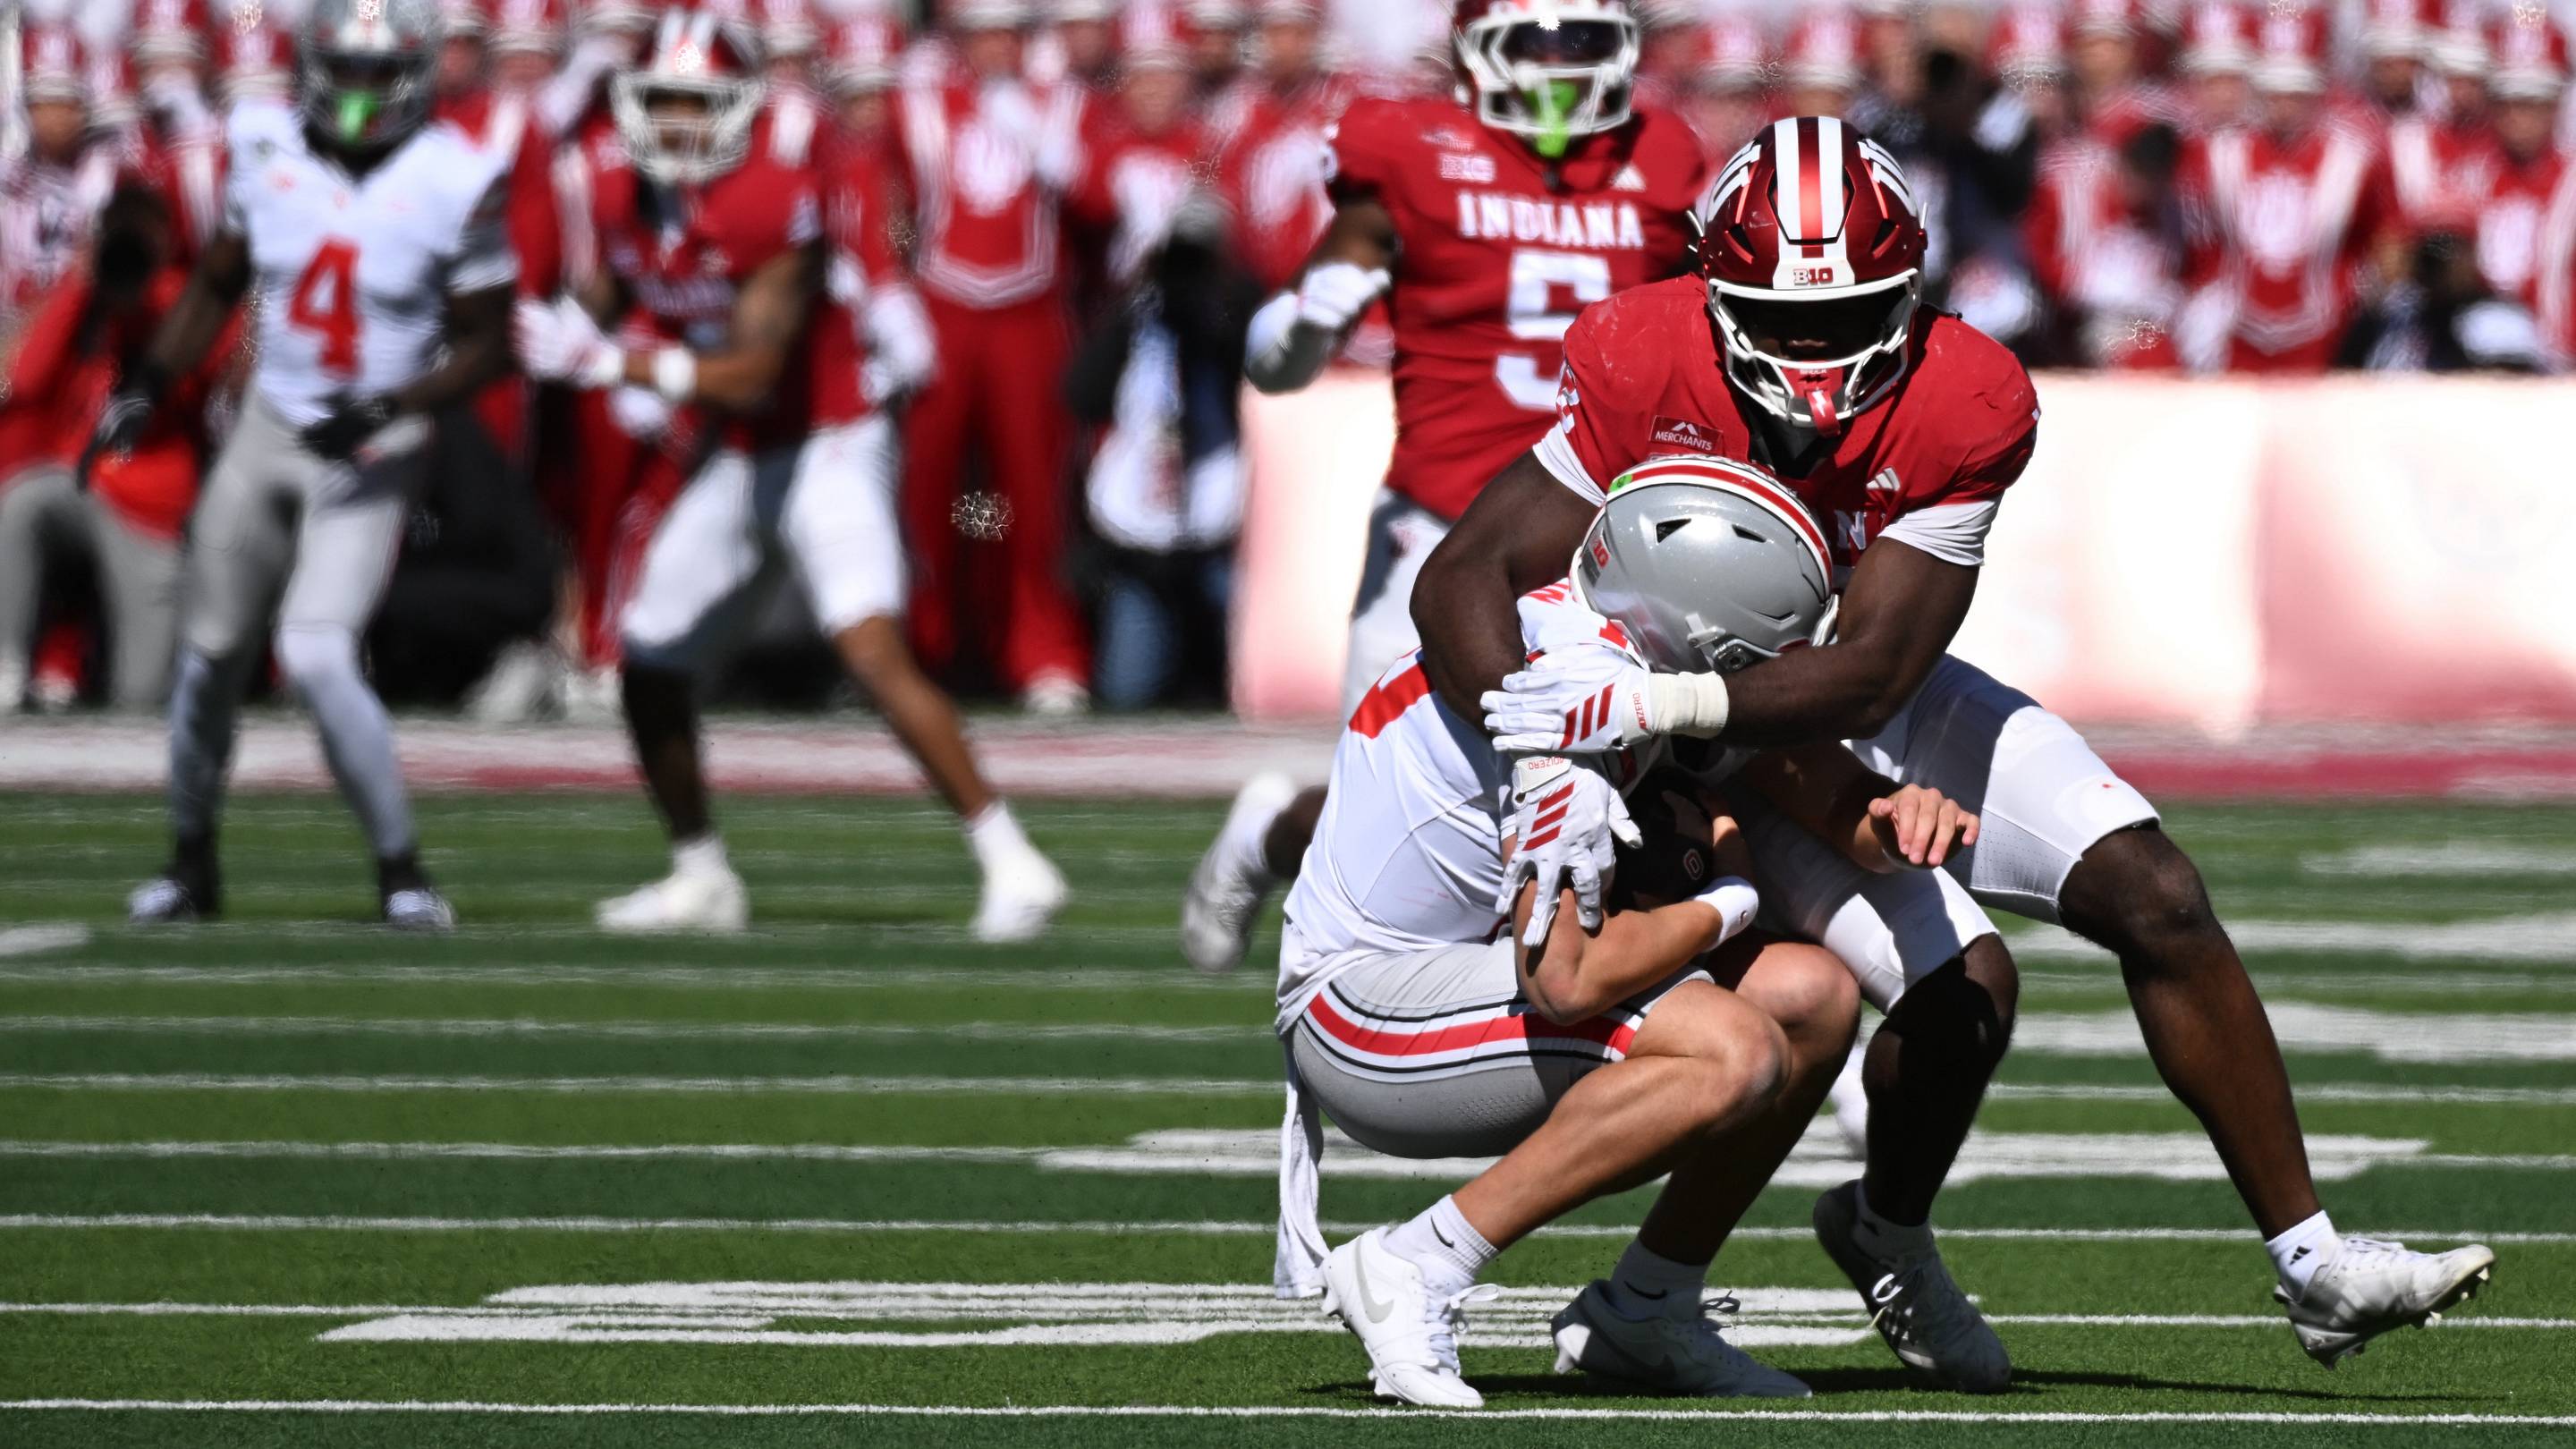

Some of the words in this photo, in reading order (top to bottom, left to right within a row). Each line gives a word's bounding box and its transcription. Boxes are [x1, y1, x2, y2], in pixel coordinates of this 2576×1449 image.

[1458, 191, 1645, 250] INDIANA
[286, 236, 364, 380] 4
[1495, 249, 1611, 411] 5
[1655, 430, 1712, 451] MERCHANTS
